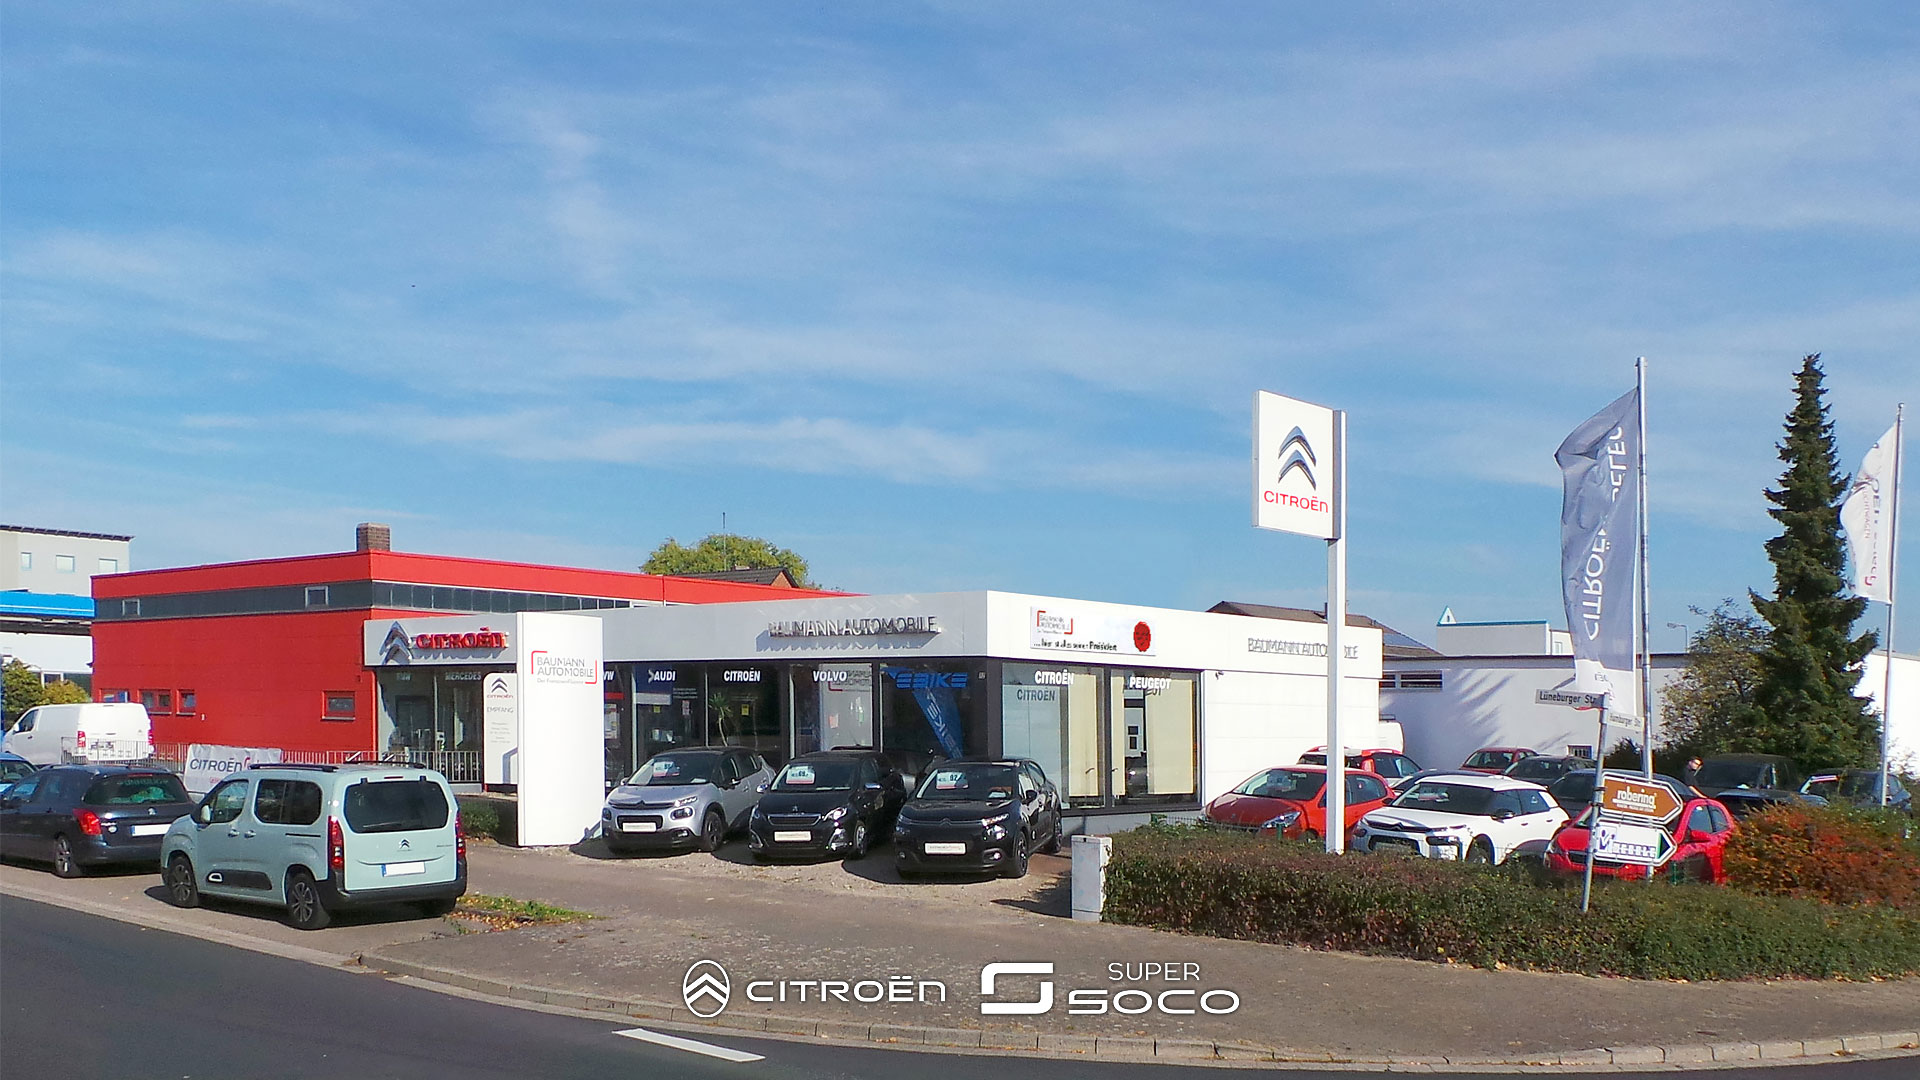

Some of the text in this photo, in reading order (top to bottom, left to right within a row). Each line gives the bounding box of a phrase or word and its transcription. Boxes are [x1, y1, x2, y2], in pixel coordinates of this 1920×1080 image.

[1264, 490, 1328, 513] CITROËN
[767, 616, 941, 637] BAUMANN AUTOMOBILE
[416, 626, 509, 649] CITROËN
[1248, 637, 1300, 655] BAUMANN
[536, 657, 585, 667] BAUMANN
[445, 671, 481, 681] MERCEDES
[653, 670, 676, 682] AUDI
[723, 667, 760, 682] CITROËN
[812, 670, 848, 682] VOLVO
[537, 666, 594, 678] AUTOMOBILE
[1035, 669, 1171, 690] CITROËN PEUGEOT
[1540, 690, 1580, 704] Lüneburger
[189, 757, 242, 772] CITROËN
[1616, 785, 1656, 806] robering
